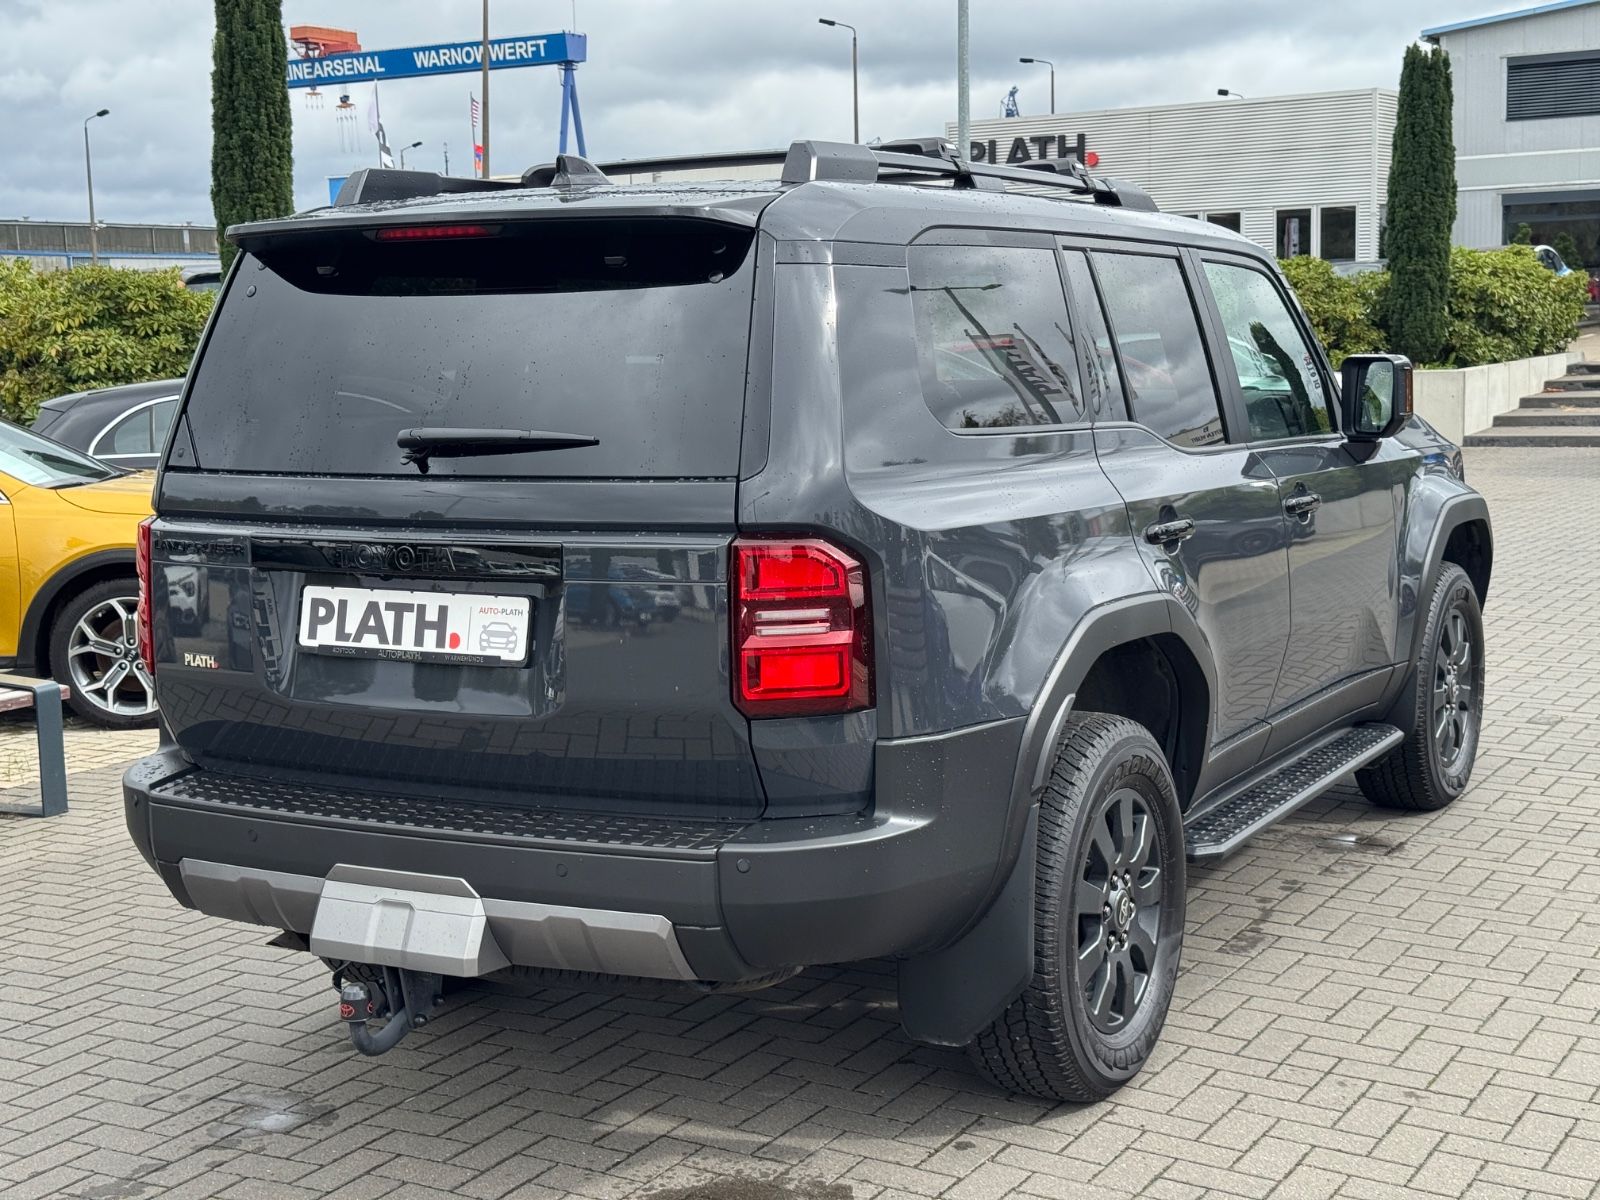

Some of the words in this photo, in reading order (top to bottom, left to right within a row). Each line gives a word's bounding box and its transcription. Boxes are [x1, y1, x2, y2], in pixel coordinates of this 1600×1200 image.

[287, 55, 386, 81] INEARSENAL
[336, 544, 456, 572] TOYOTA
[478, 606, 524, 617] AUTO-PLATH
